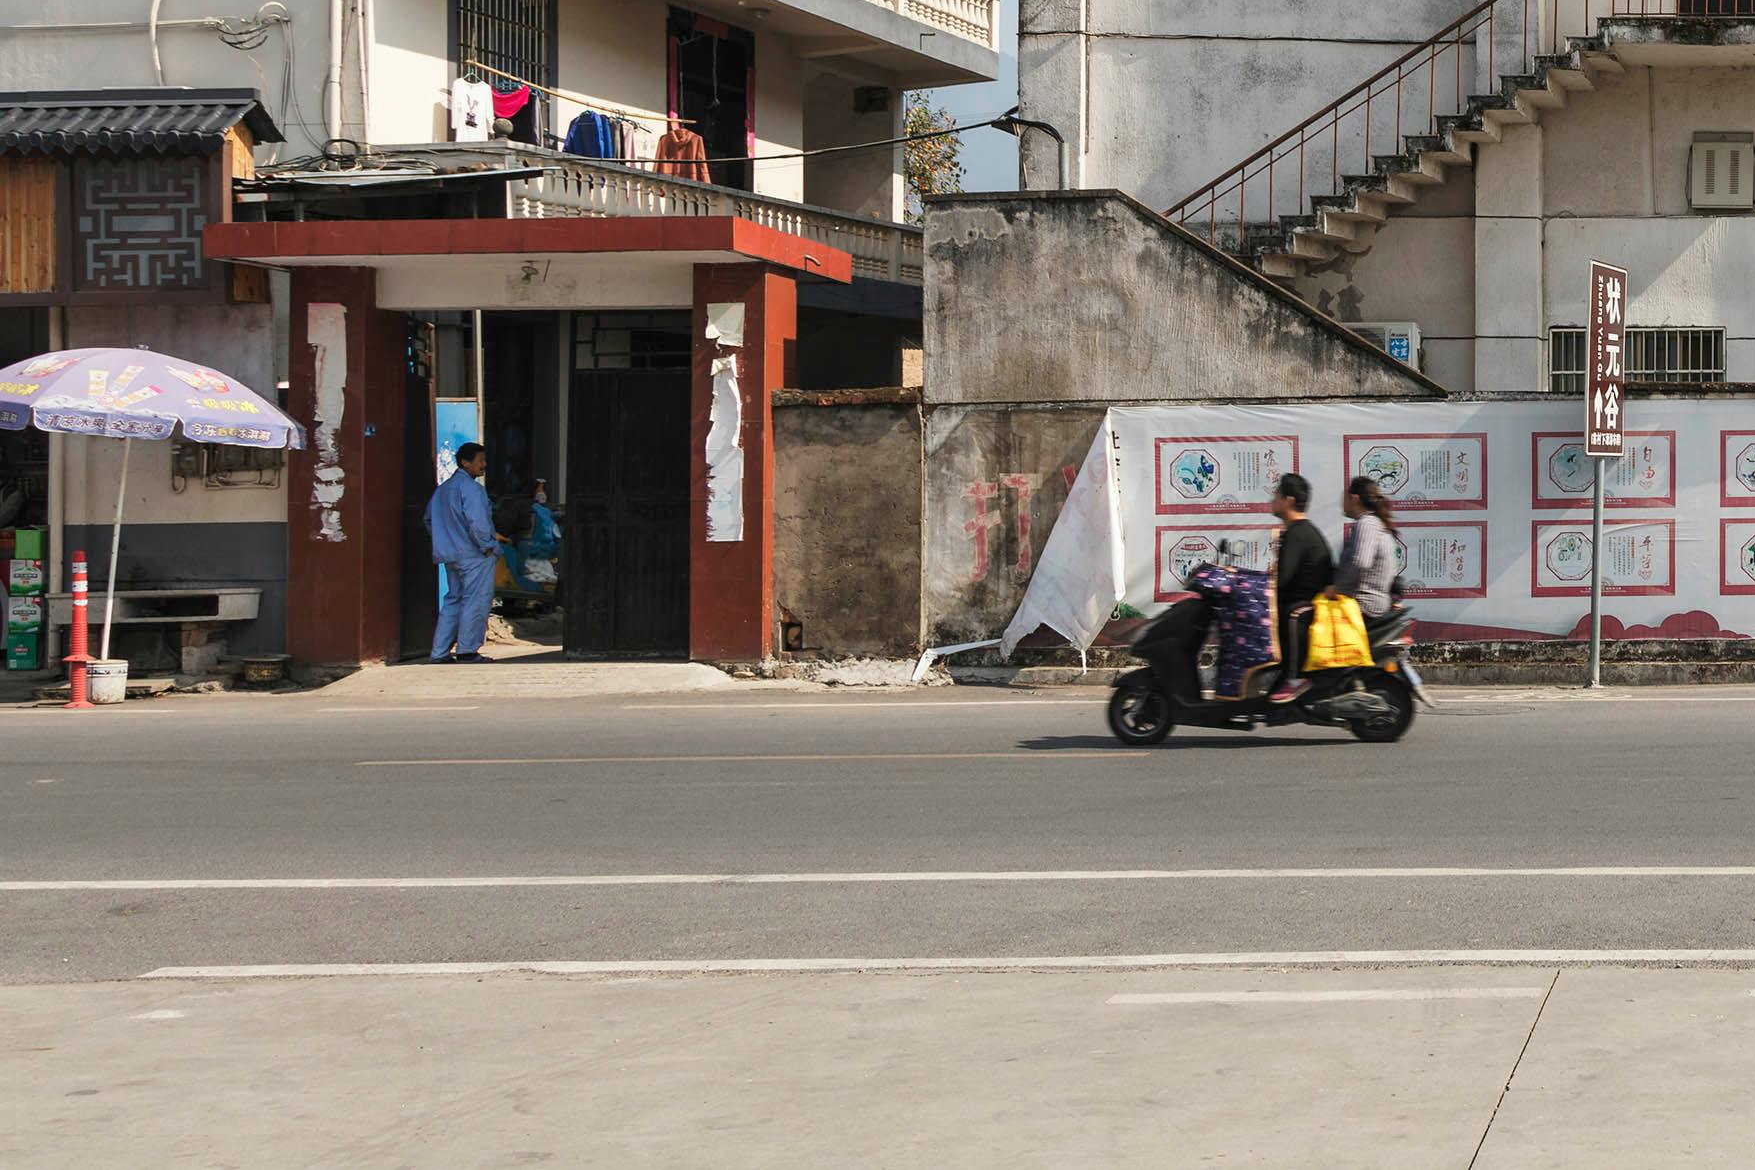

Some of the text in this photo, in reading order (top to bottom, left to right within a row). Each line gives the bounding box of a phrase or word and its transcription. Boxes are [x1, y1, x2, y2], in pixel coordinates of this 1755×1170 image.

[1603, 277, 1621, 429] 状元谷
[1456, 450, 1470, 483] 文明
[1642, 446, 1657, 479] 自由
